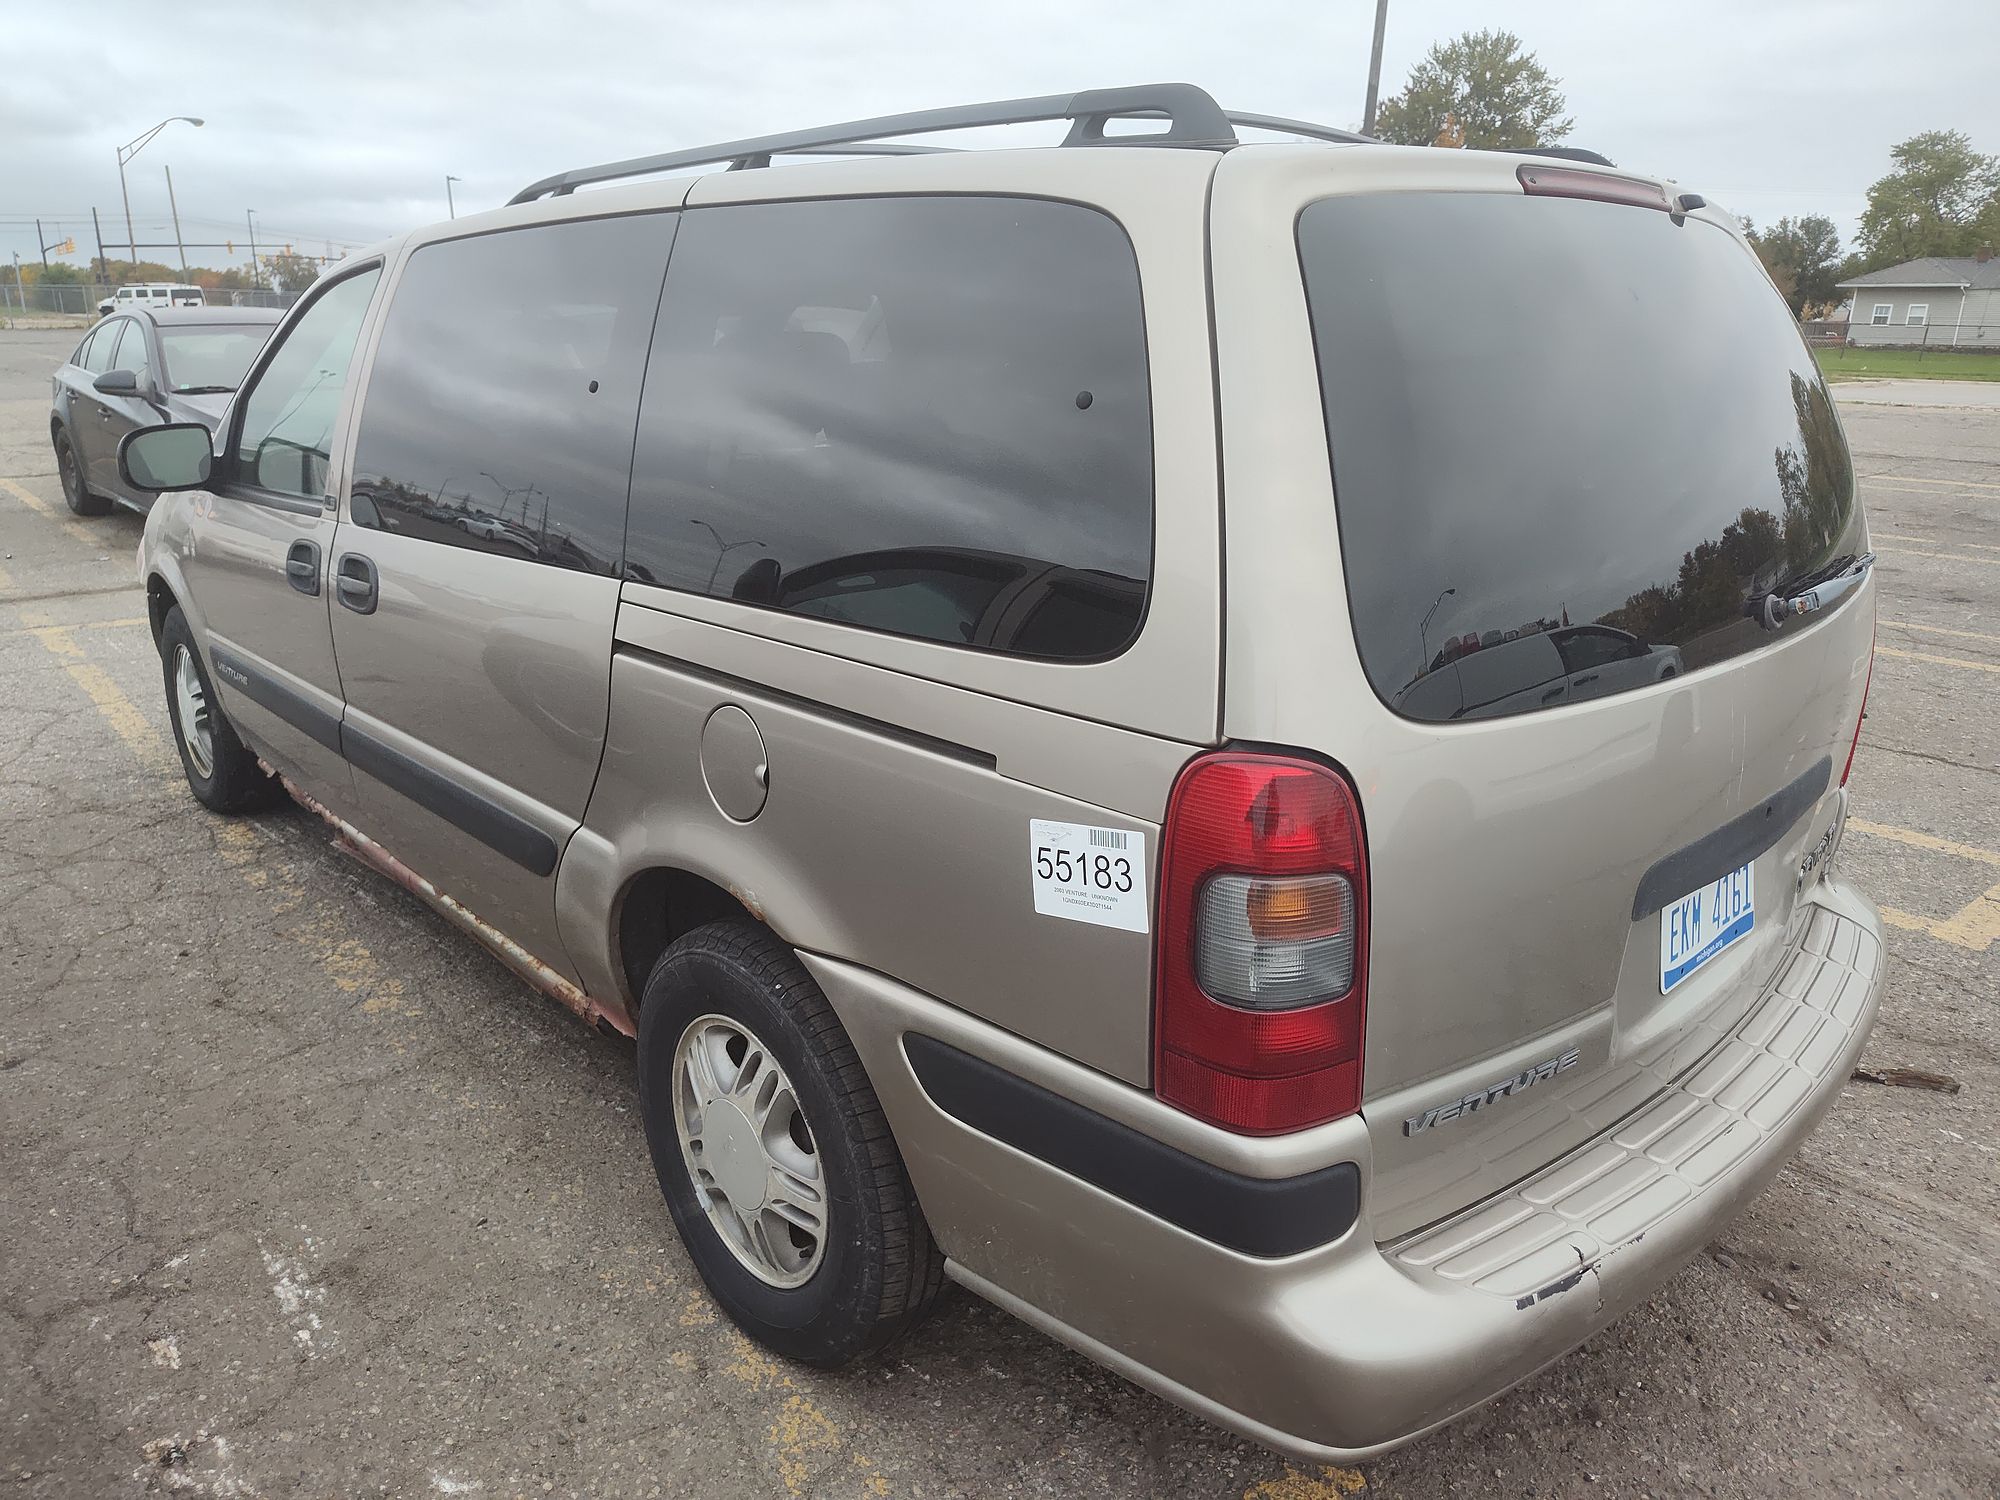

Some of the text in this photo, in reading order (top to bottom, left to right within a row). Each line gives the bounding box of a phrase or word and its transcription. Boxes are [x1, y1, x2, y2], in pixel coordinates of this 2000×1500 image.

[1037, 846, 1133, 893] 55183
[1064, 888, 1088, 898] VENTURE
[1670, 863, 1751, 962] EKM 4161
[1403, 1046, 1581, 1137] VENTURE
